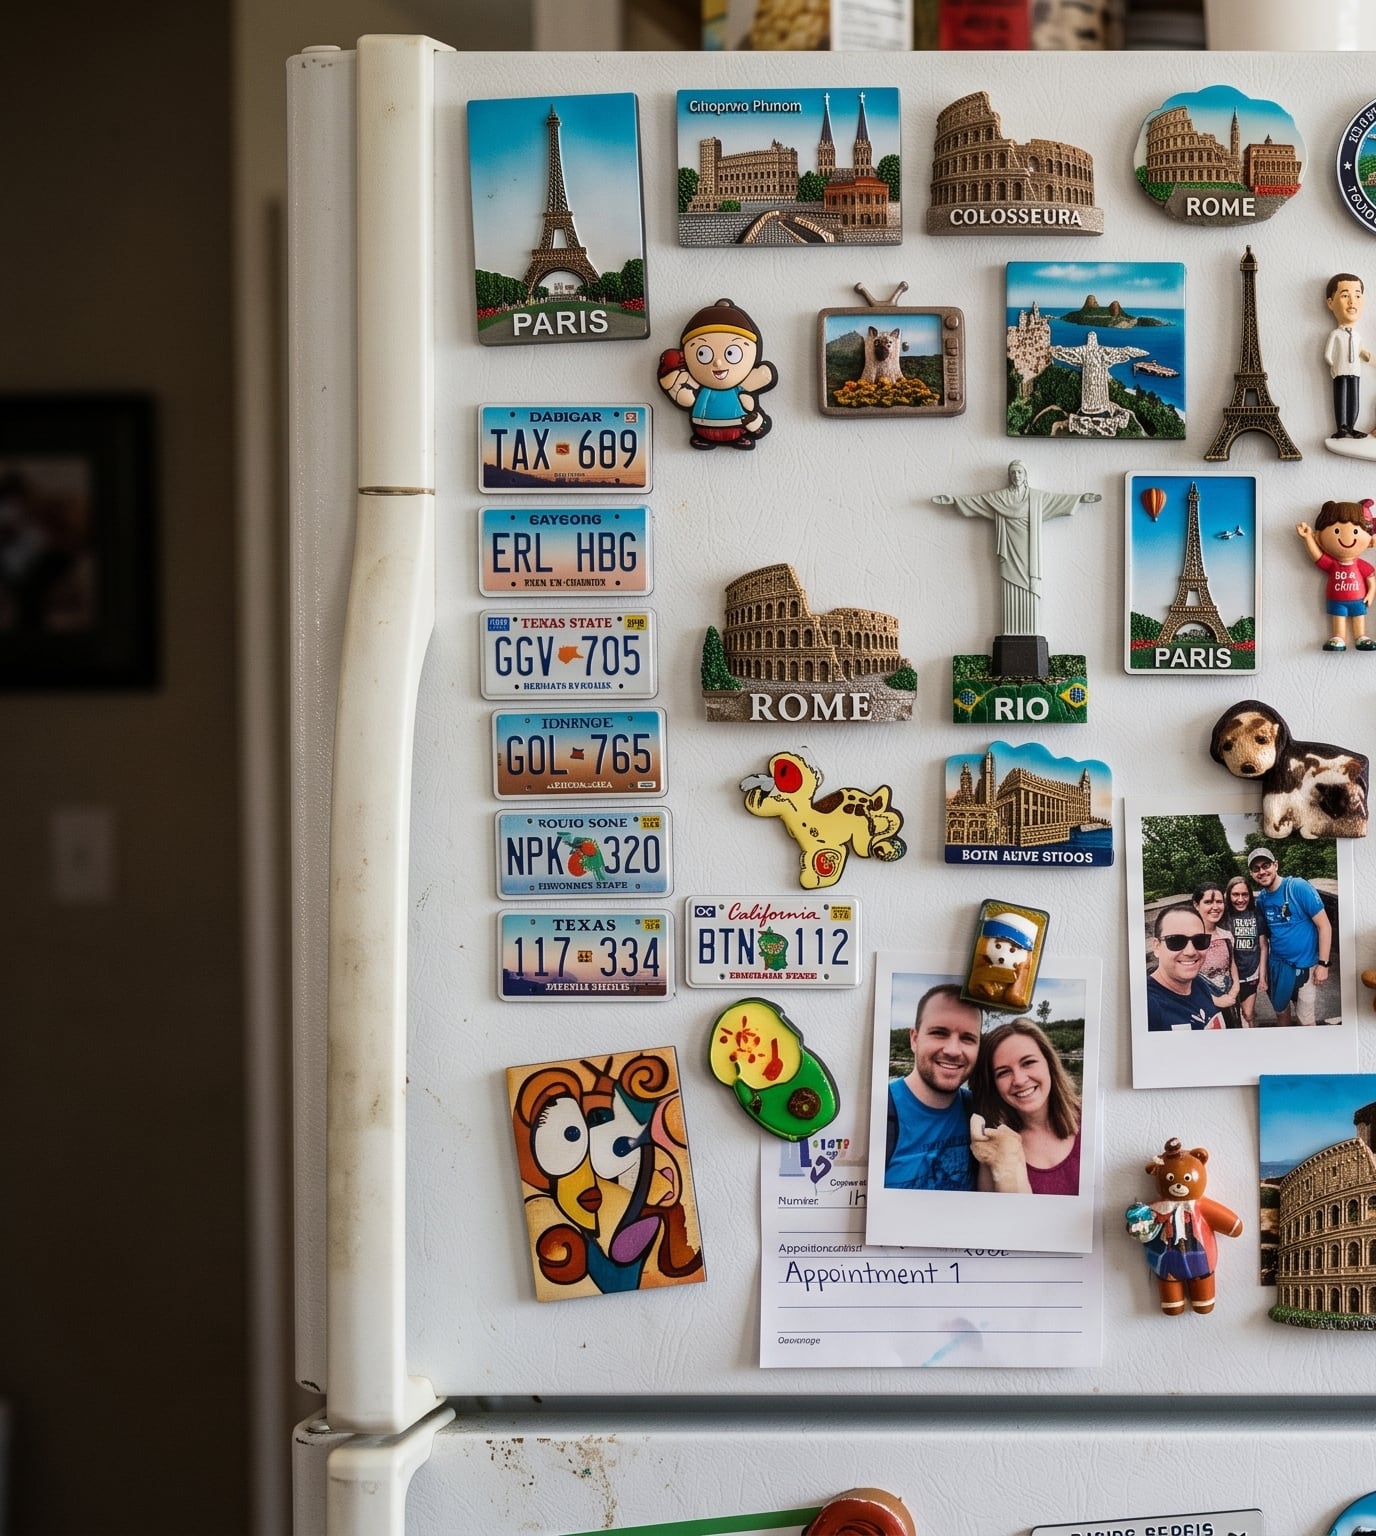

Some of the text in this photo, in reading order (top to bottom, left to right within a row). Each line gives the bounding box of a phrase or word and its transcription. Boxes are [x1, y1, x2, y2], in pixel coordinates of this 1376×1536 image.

[1186, 197, 1256, 217] ROME
[512, 308, 609, 338] PARIS
[490, 428, 638, 471] TAX 689
[492, 531, 637, 573] ERL HBG
[569, 617, 613, 629] STATE
[495, 635, 641, 677] GGV 705
[1154, 646, 1232, 669] PARIS
[750, 692, 873, 722] ROME
[995, 697, 1050, 721] RIO
[506, 733, 651, 776] GOL 765
[588, 817, 628, 828] SONE
[507, 834, 661, 876] NPK 320
[552, 919, 617, 932] TEXAS
[728, 903, 821, 928] California
[514, 936, 660, 977] 117 334
[699, 927, 849, 966] BTN 112
[785, 1260, 961, 1292] Appointment 1
